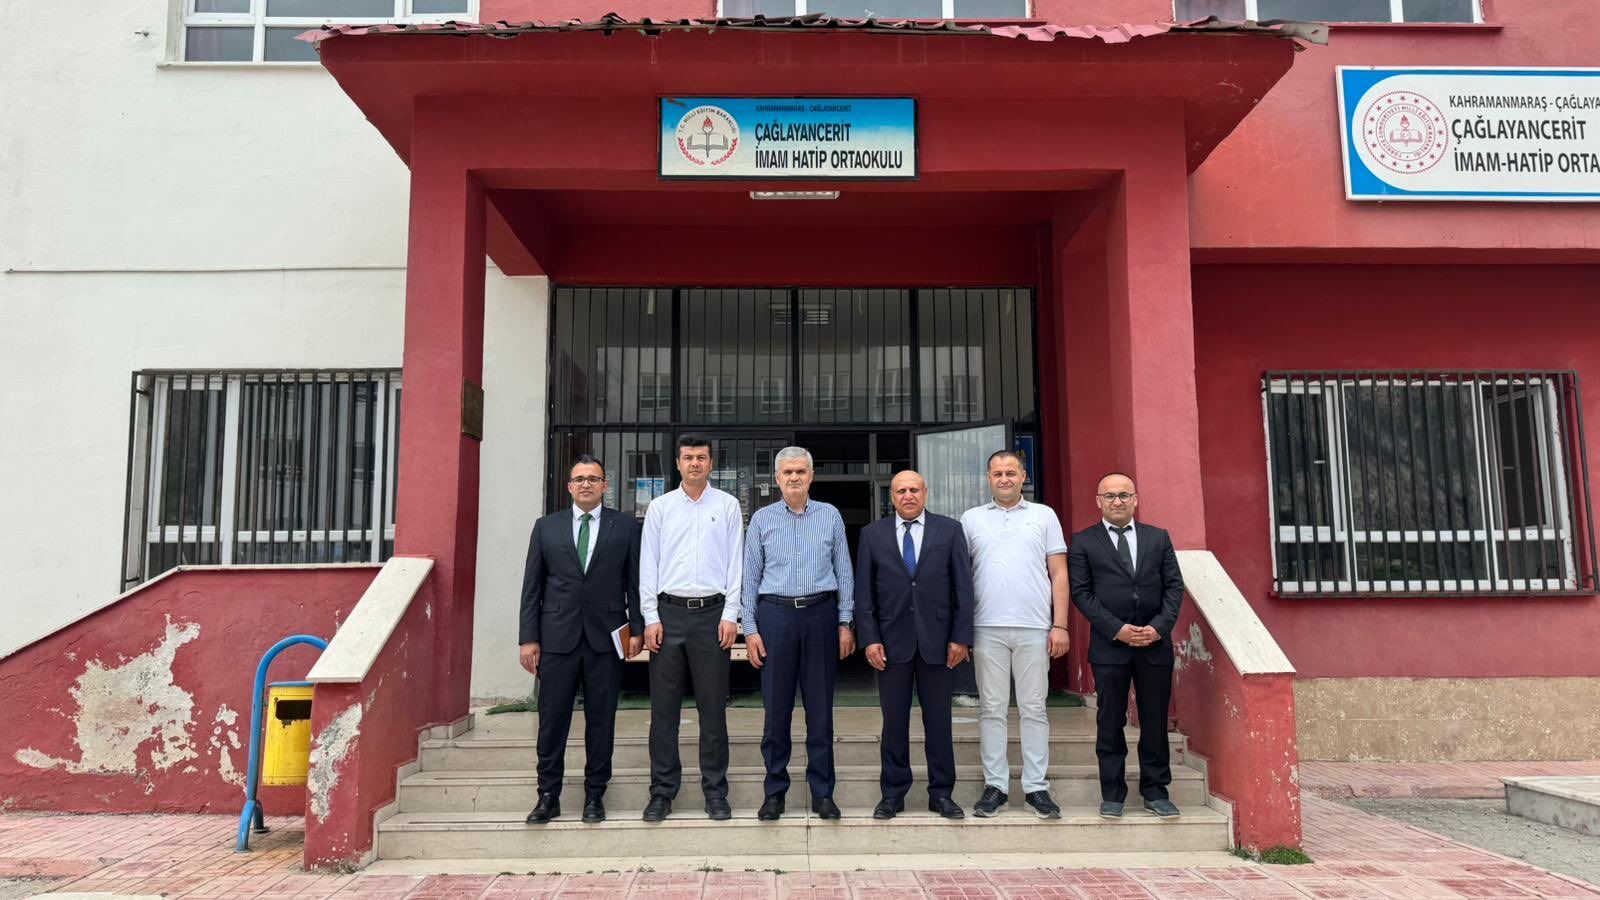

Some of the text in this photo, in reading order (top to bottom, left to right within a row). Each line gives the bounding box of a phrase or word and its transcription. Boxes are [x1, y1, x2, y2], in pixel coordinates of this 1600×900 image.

[1449, 95, 1548, 111] KAHRAMANMARAŞ
[755, 118, 852, 146] ÇAĞLAYANCERİT
[1451, 115, 1587, 144] ÇAĞLAYANCERİT
[755, 146, 903, 169] İMAM HATİP ORTAOKULU
[1454, 147, 1600, 174] İMAM-HATİP ORTA
